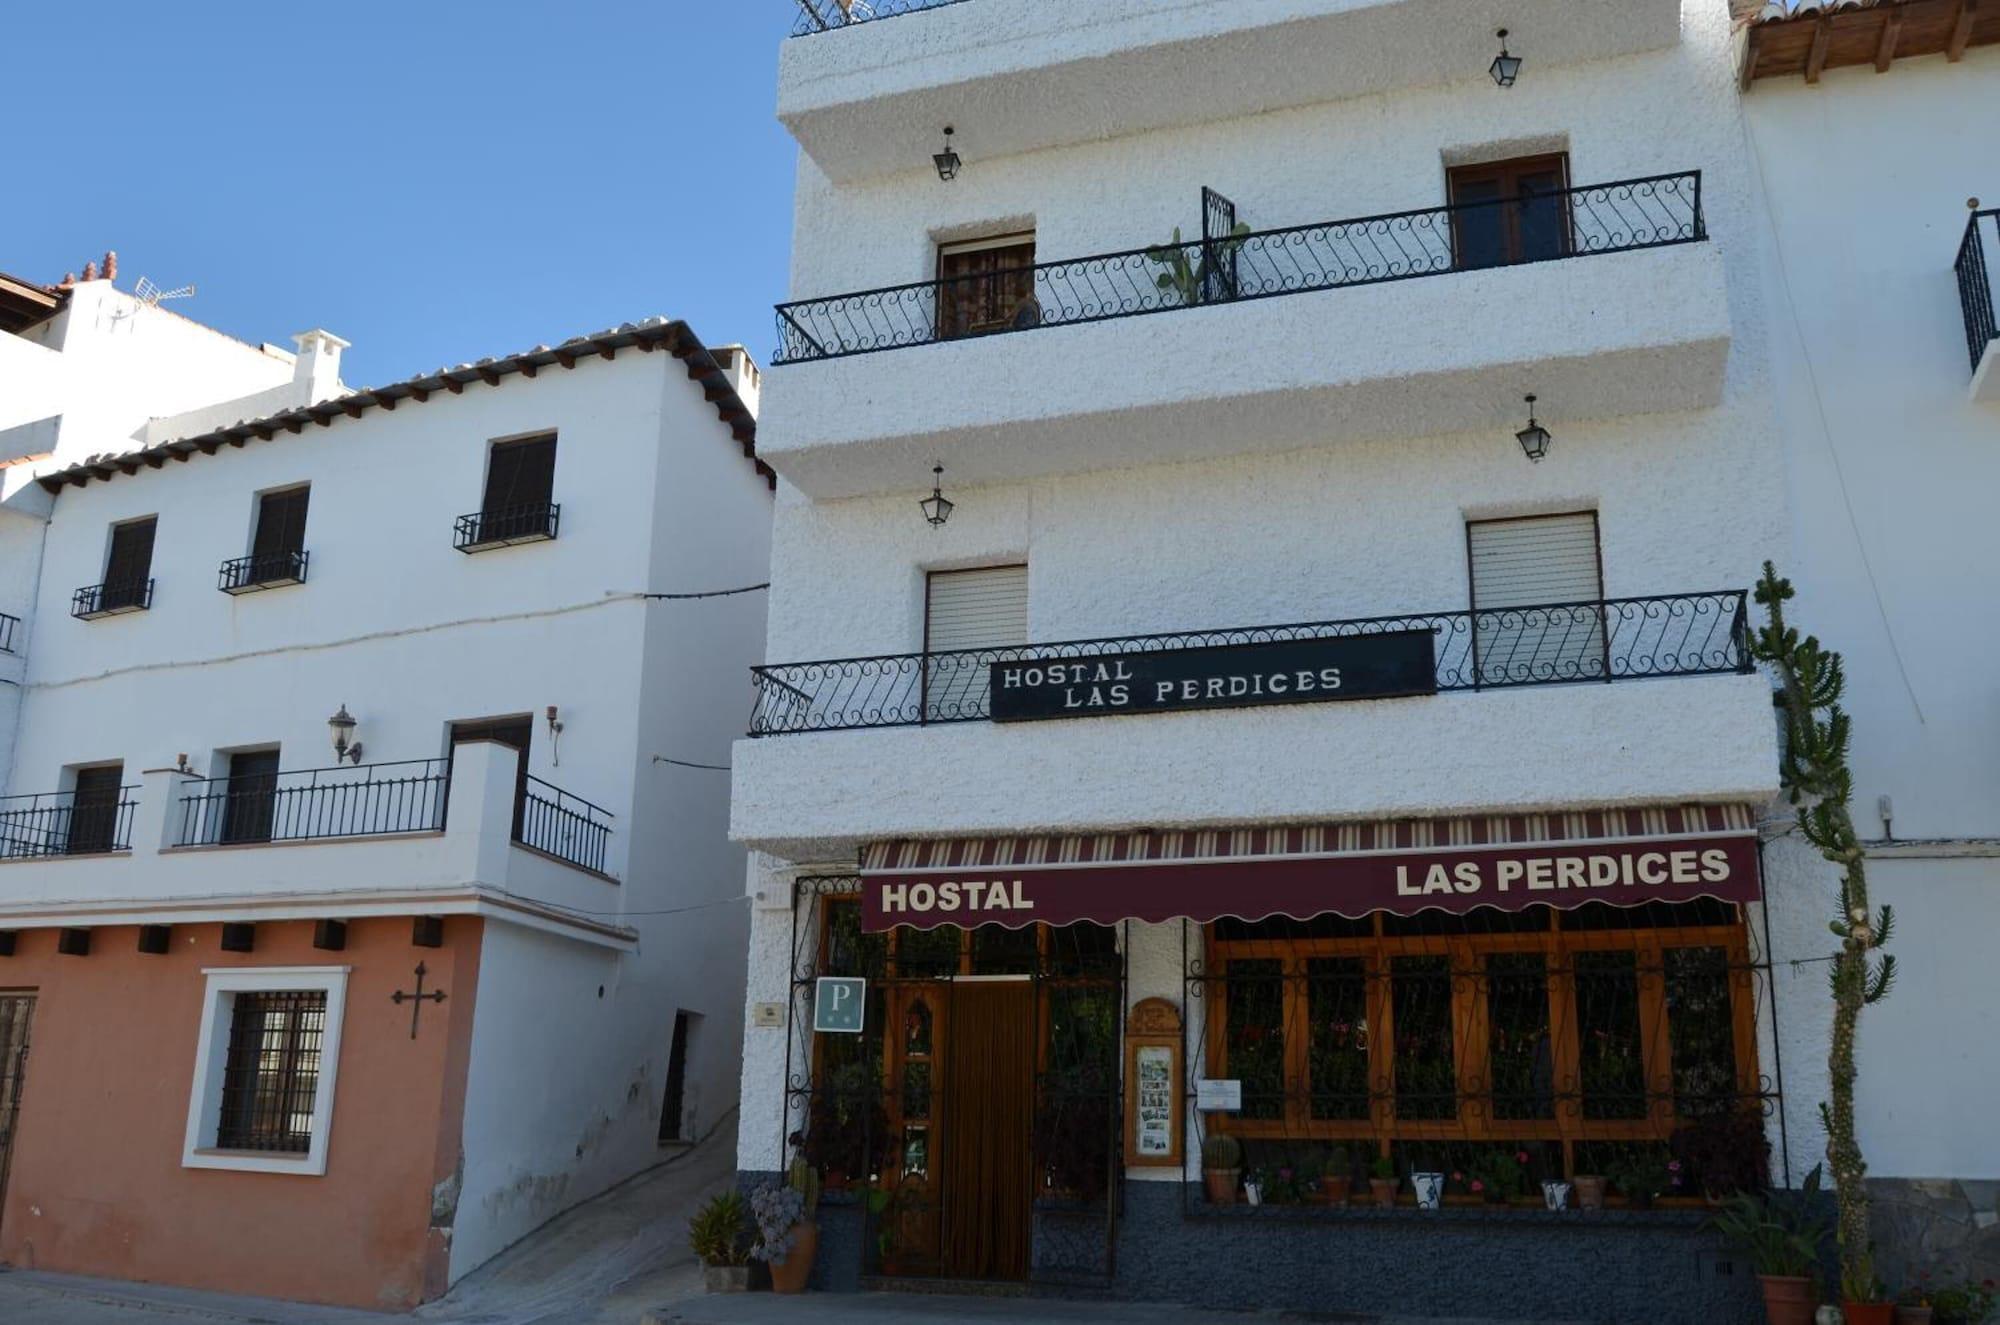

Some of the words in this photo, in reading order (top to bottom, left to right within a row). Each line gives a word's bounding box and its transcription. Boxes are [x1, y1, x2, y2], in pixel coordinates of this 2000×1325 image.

[1003, 661, 1133, 688] HOSTAL
[1064, 685, 1129, 708] LAS
[1156, 668, 1341, 701] PERDICES
[882, 880, 1034, 913] HOSTAL
[1397, 862, 1482, 896] LAS
[1497, 849, 1731, 892] PERDICES
[831, 984, 850, 1012] P
